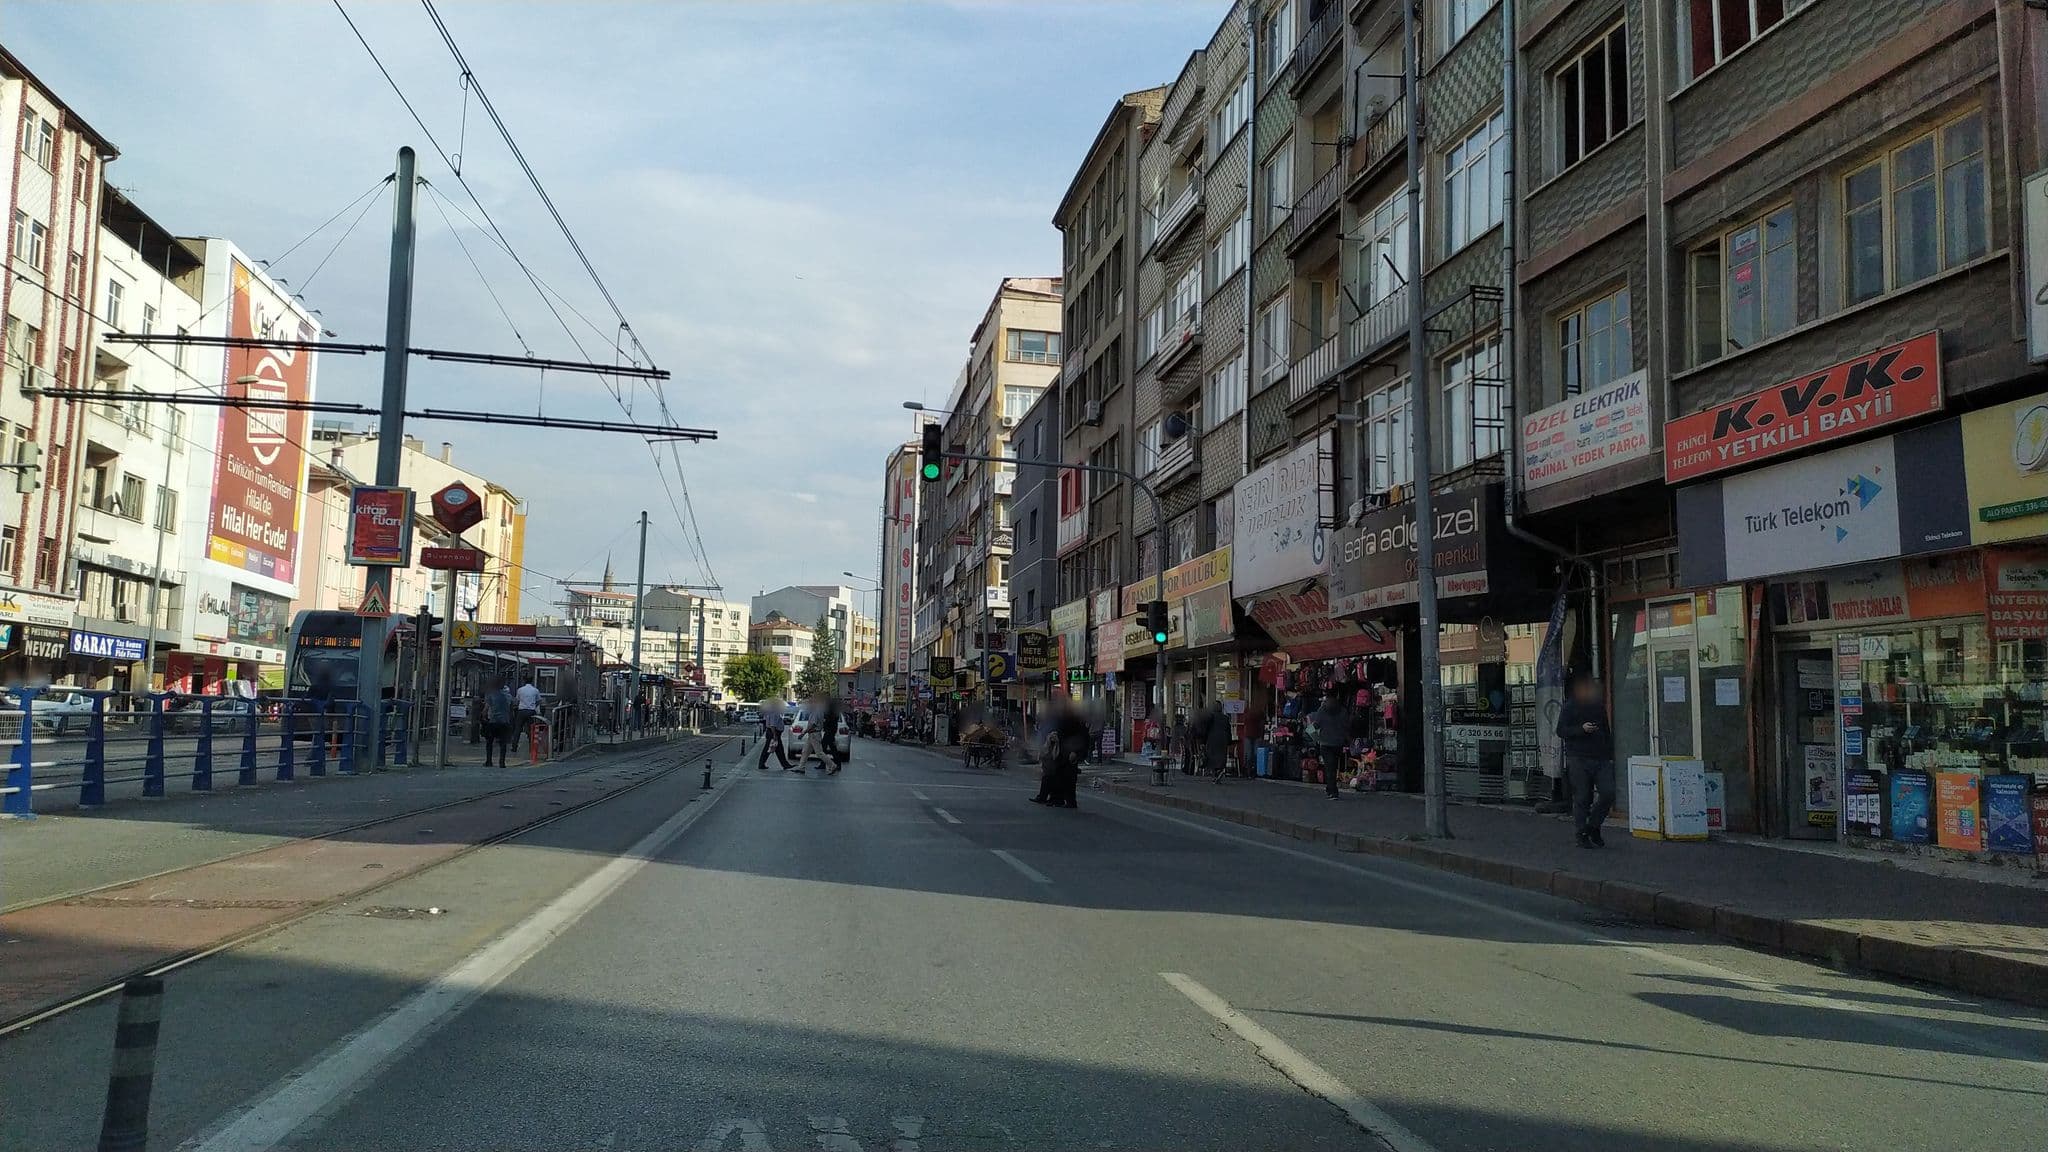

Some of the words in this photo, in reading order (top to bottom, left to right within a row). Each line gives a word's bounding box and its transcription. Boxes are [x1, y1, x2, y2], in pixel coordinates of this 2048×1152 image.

[1525, 409, 1569, 437] ÖZEL
[1573, 380, 1641, 419] ELEKTRİK
[1717, 417, 1810, 461] YETKİLİ
[1819, 391, 1893, 432] BAYİİ
[1528, 458, 1568, 480] ORJINAL
[1571, 445, 1605, 470] YEDEK
[1609, 432, 1647, 455] PARÇA
[1673, 449, 1712, 470] TELEFON
[1677, 433, 1707, 451] EKİNCİ
[227, 453, 254, 482] Evinizin
[254, 466, 268, 486] Tüm
[268, 473, 292, 500] Renkleri
[246, 487, 272, 515] Hilal'de
[355, 504, 388, 516] kitap
[1744, 511, 1778, 534] Türk
[1782, 499, 1850, 527] Telekom
[222, 504, 245, 535] Hilal
[246, 513, 263, 541] Her
[263, 521, 288, 551] Evde!
[1344, 527, 1377, 563] safa
[24, 639, 65, 659] NEVZAT
[73, 634, 115, 655] SARAY
